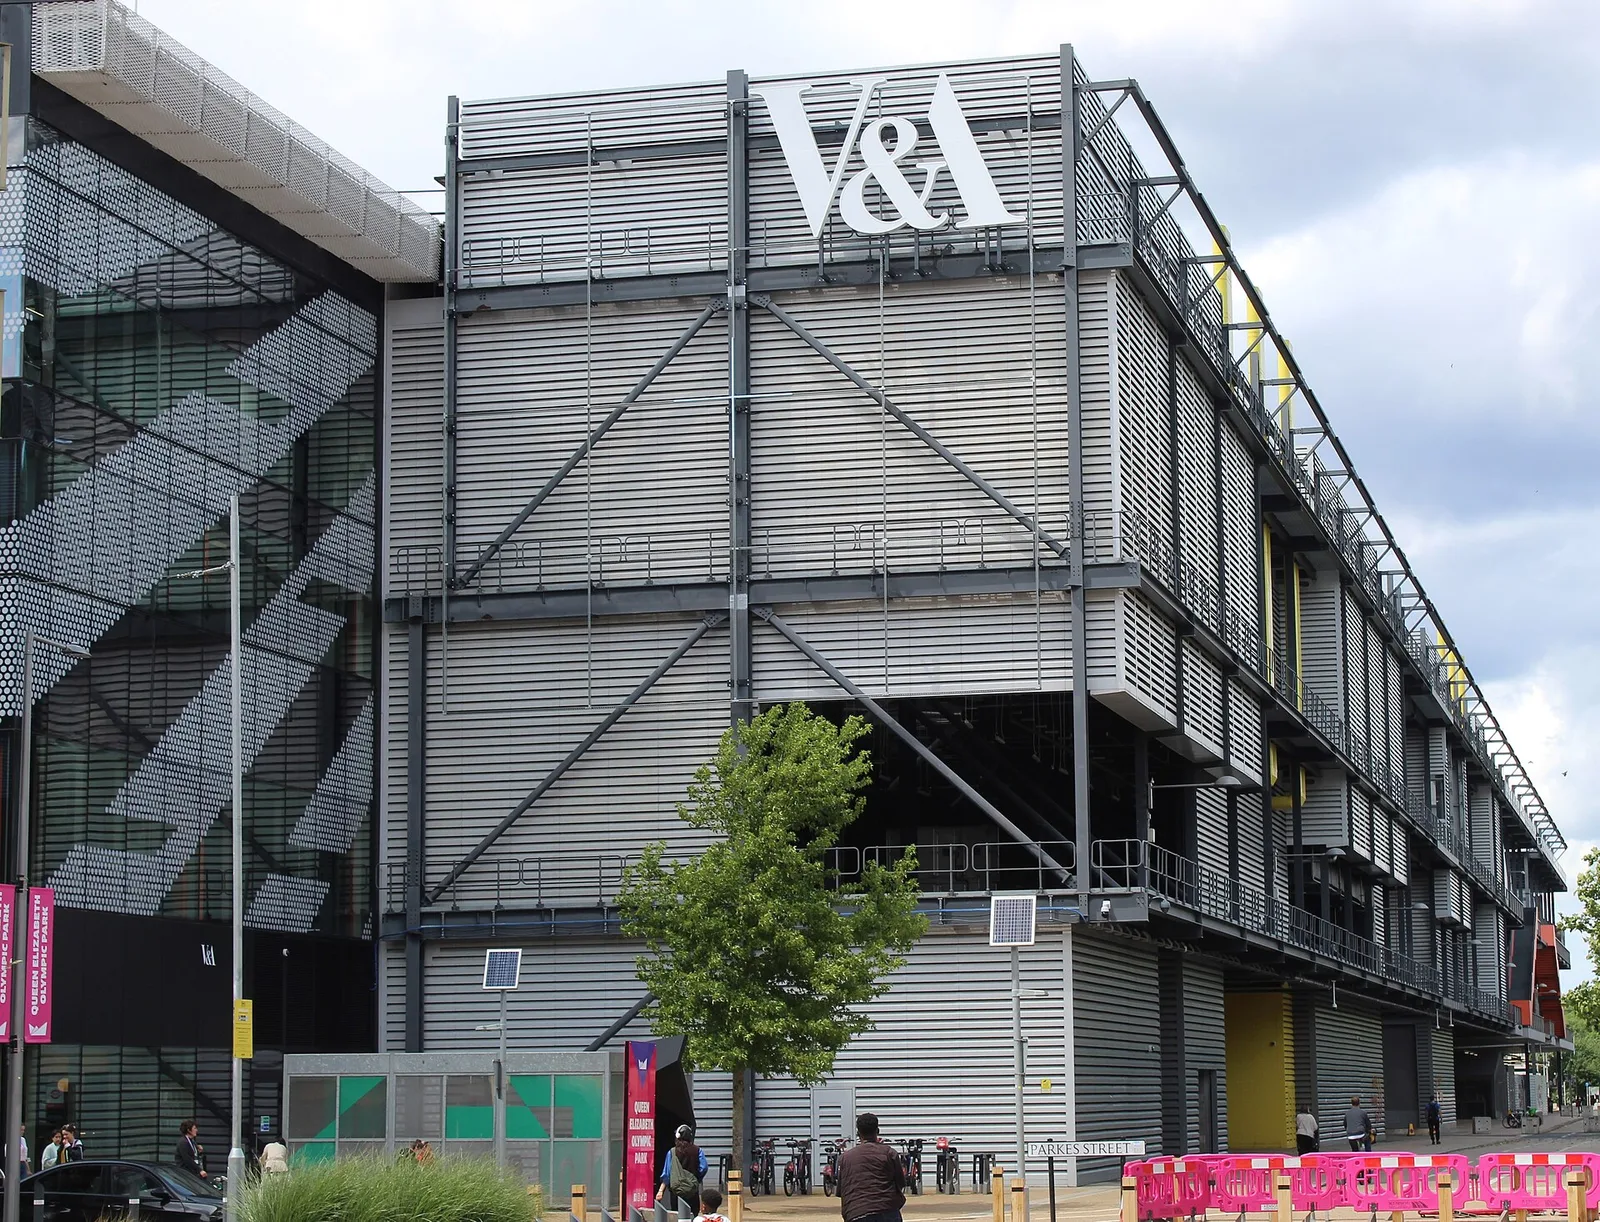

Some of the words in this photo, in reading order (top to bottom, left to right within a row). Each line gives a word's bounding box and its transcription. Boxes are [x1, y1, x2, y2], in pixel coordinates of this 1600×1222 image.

[748, 72, 1026, 238] V&A
[2, 903, 10, 940] PARK
[32, 895, 41, 967] ELIZABETH
[41, 906, 49, 943] PARK
[0, 943, 8, 1003] OLYMPIC
[201, 944, 216, 966] V&A
[31, 970, 39, 1015] QUEEN
[40, 945, 48, 1004] OLYMPIC
[629, 1118, 654, 1130] ELIZABETH
[634, 1101, 650, 1114] QUEEN
[631, 1135, 652, 1147] OLYMPIC
[634, 1152, 648, 1164] PARK
[1030, 1144, 1080, 1155] PARKES
[1083, 1142, 1131, 1154] STREET
